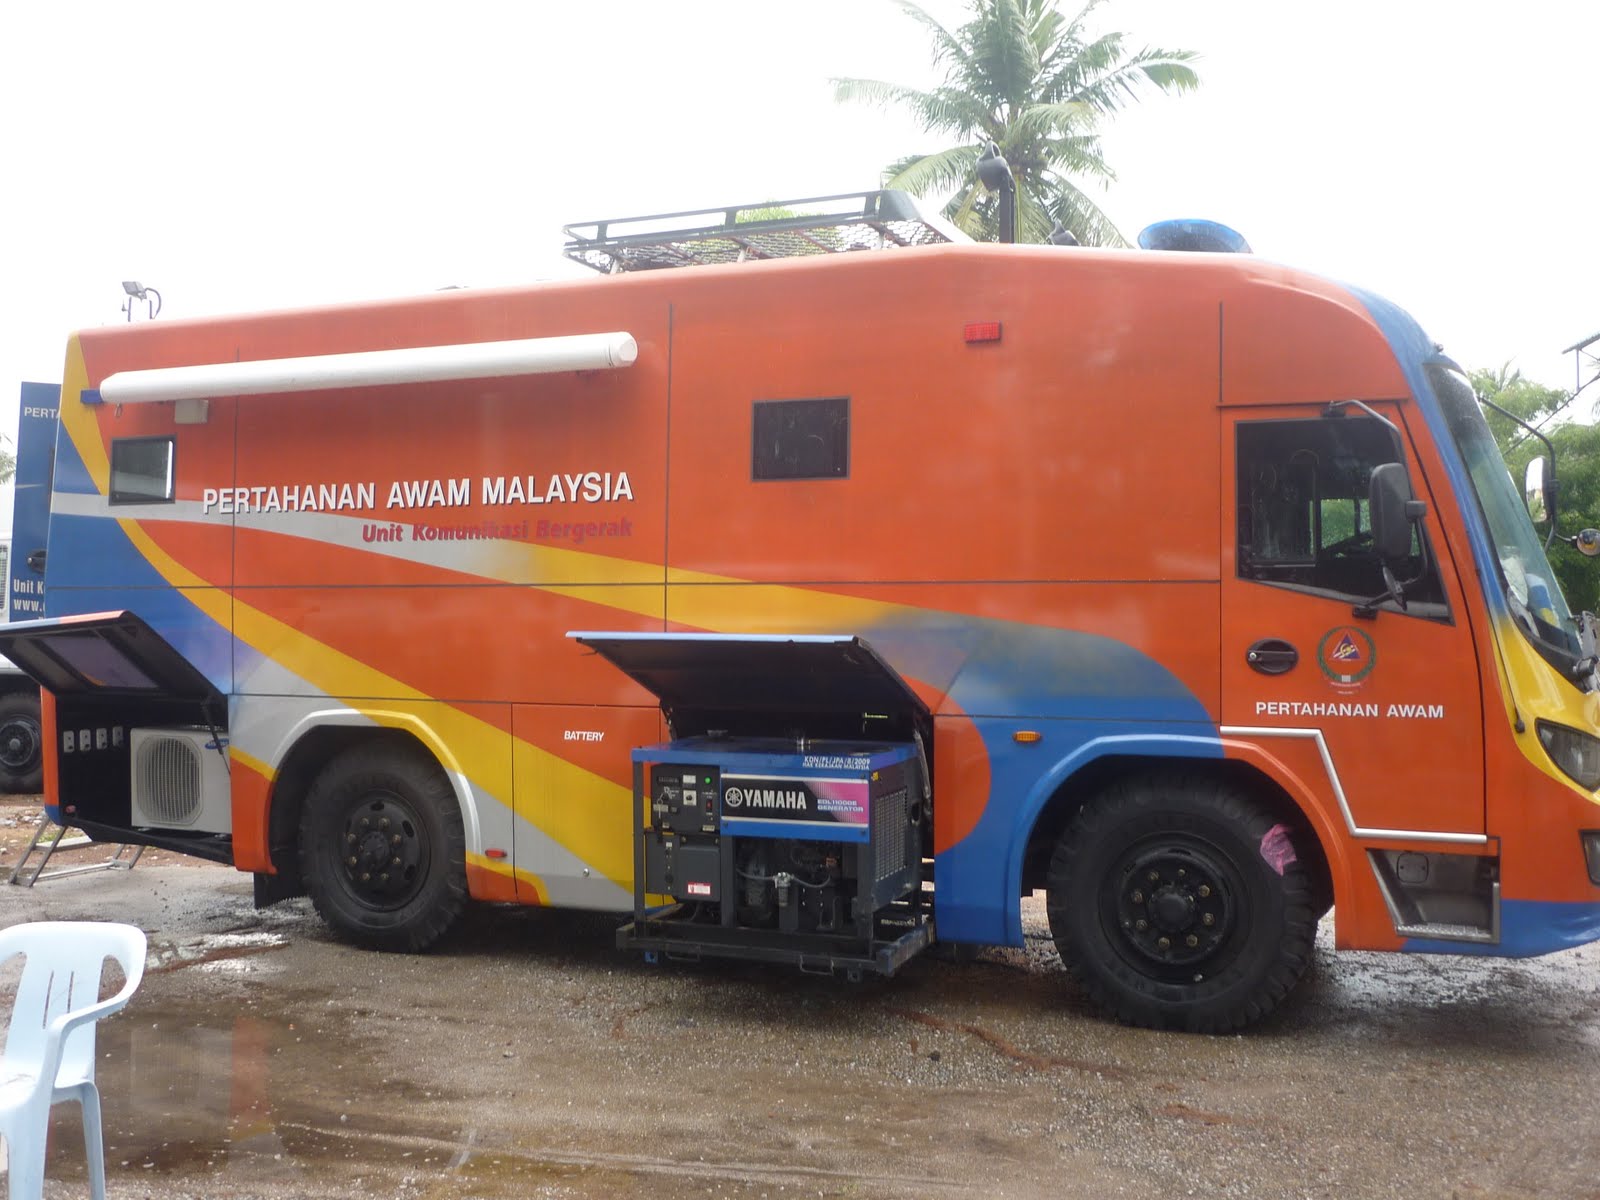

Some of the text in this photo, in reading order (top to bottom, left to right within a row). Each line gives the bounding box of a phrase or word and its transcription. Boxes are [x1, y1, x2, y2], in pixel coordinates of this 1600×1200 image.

[203, 471, 634, 514] PERTAHANAN AWAM MALAYSIA
[362, 517, 633, 543] Unit Komunikasi Bergerak
[13, 579, 46, 594] Unit K
[13, 599, 46, 612] www.
[1256, 702, 1444, 718] PERTAHANAN AWAM
[564, 730, 605, 742] BATTERY
[743, 789, 807, 810] YAMAHA
